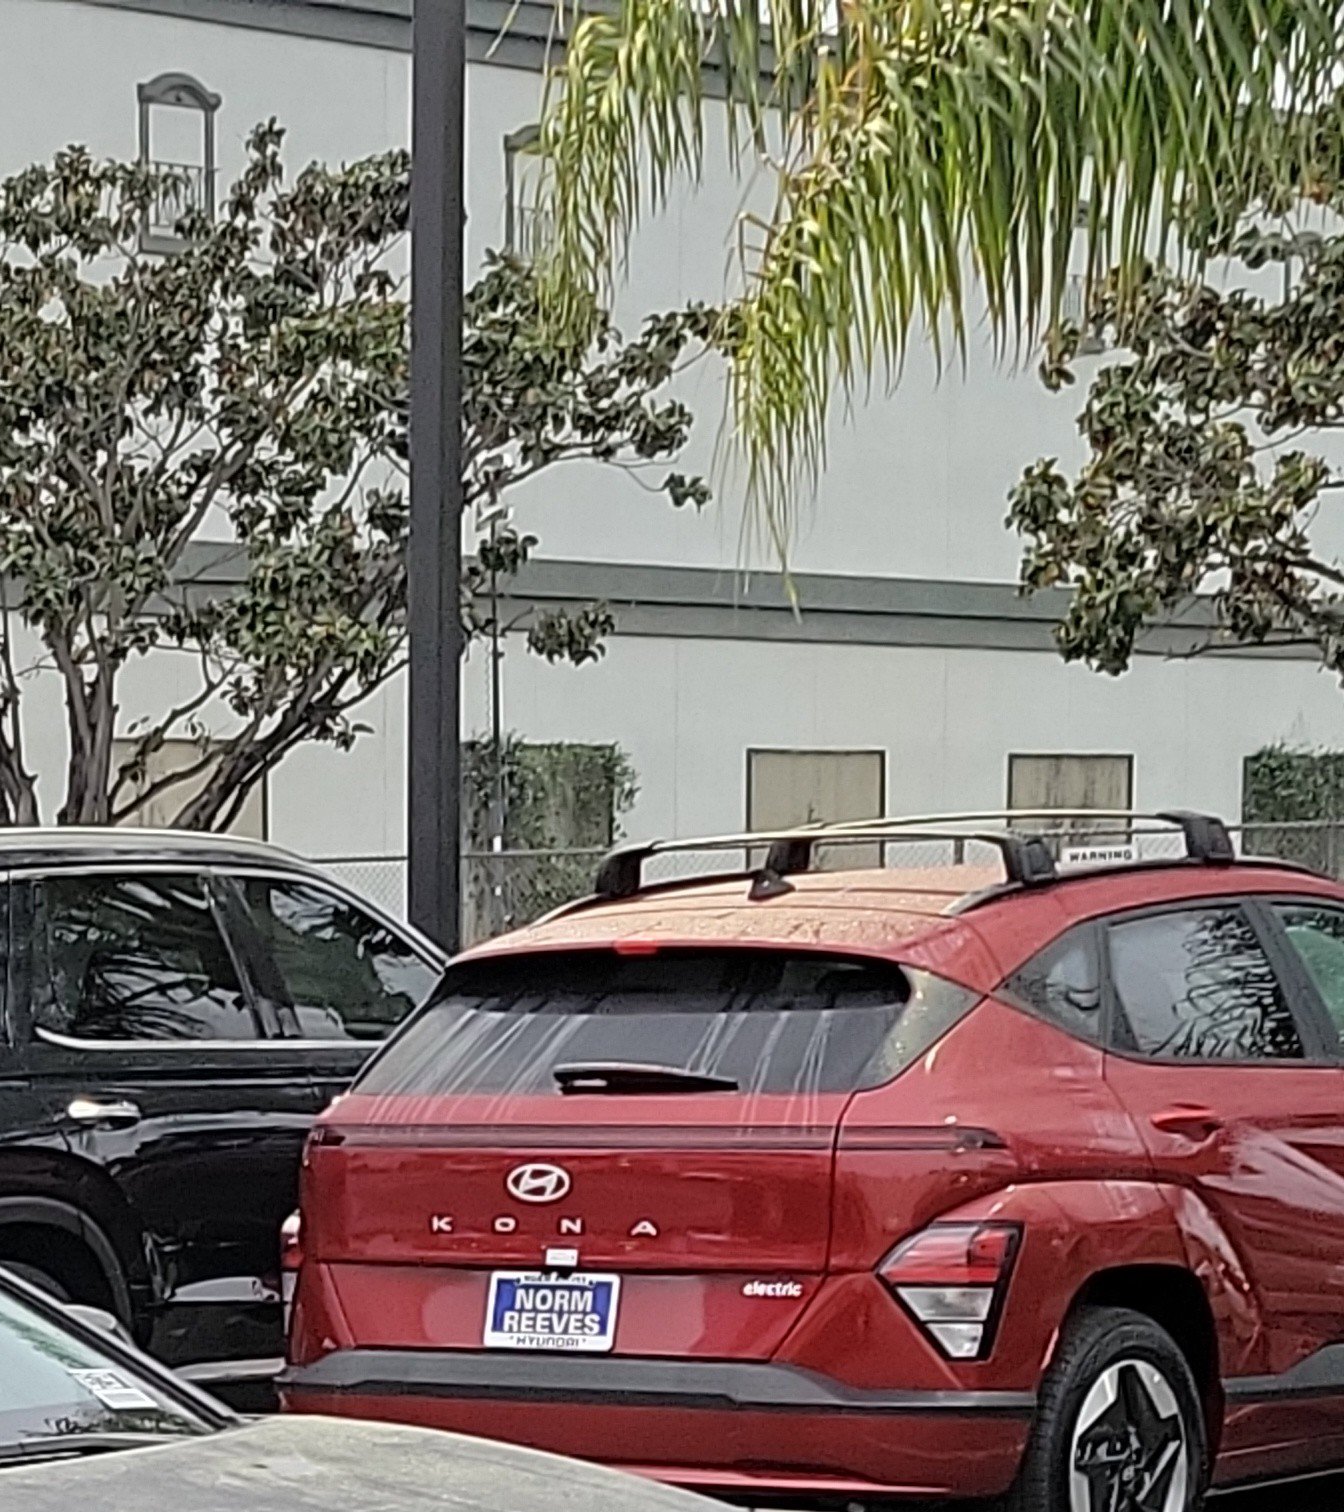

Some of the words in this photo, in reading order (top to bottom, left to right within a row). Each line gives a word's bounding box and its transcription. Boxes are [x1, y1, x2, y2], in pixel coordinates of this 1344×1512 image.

[1069, 849, 1132, 862] WARNING
[431, 1215, 658, 1237] KONA
[743, 1280, 803, 1297] electric
[514, 1288, 593, 1312] NORM
[502, 1311, 601, 1335] REEVES
[516, 1335, 579, 1348] HYUNDAI
